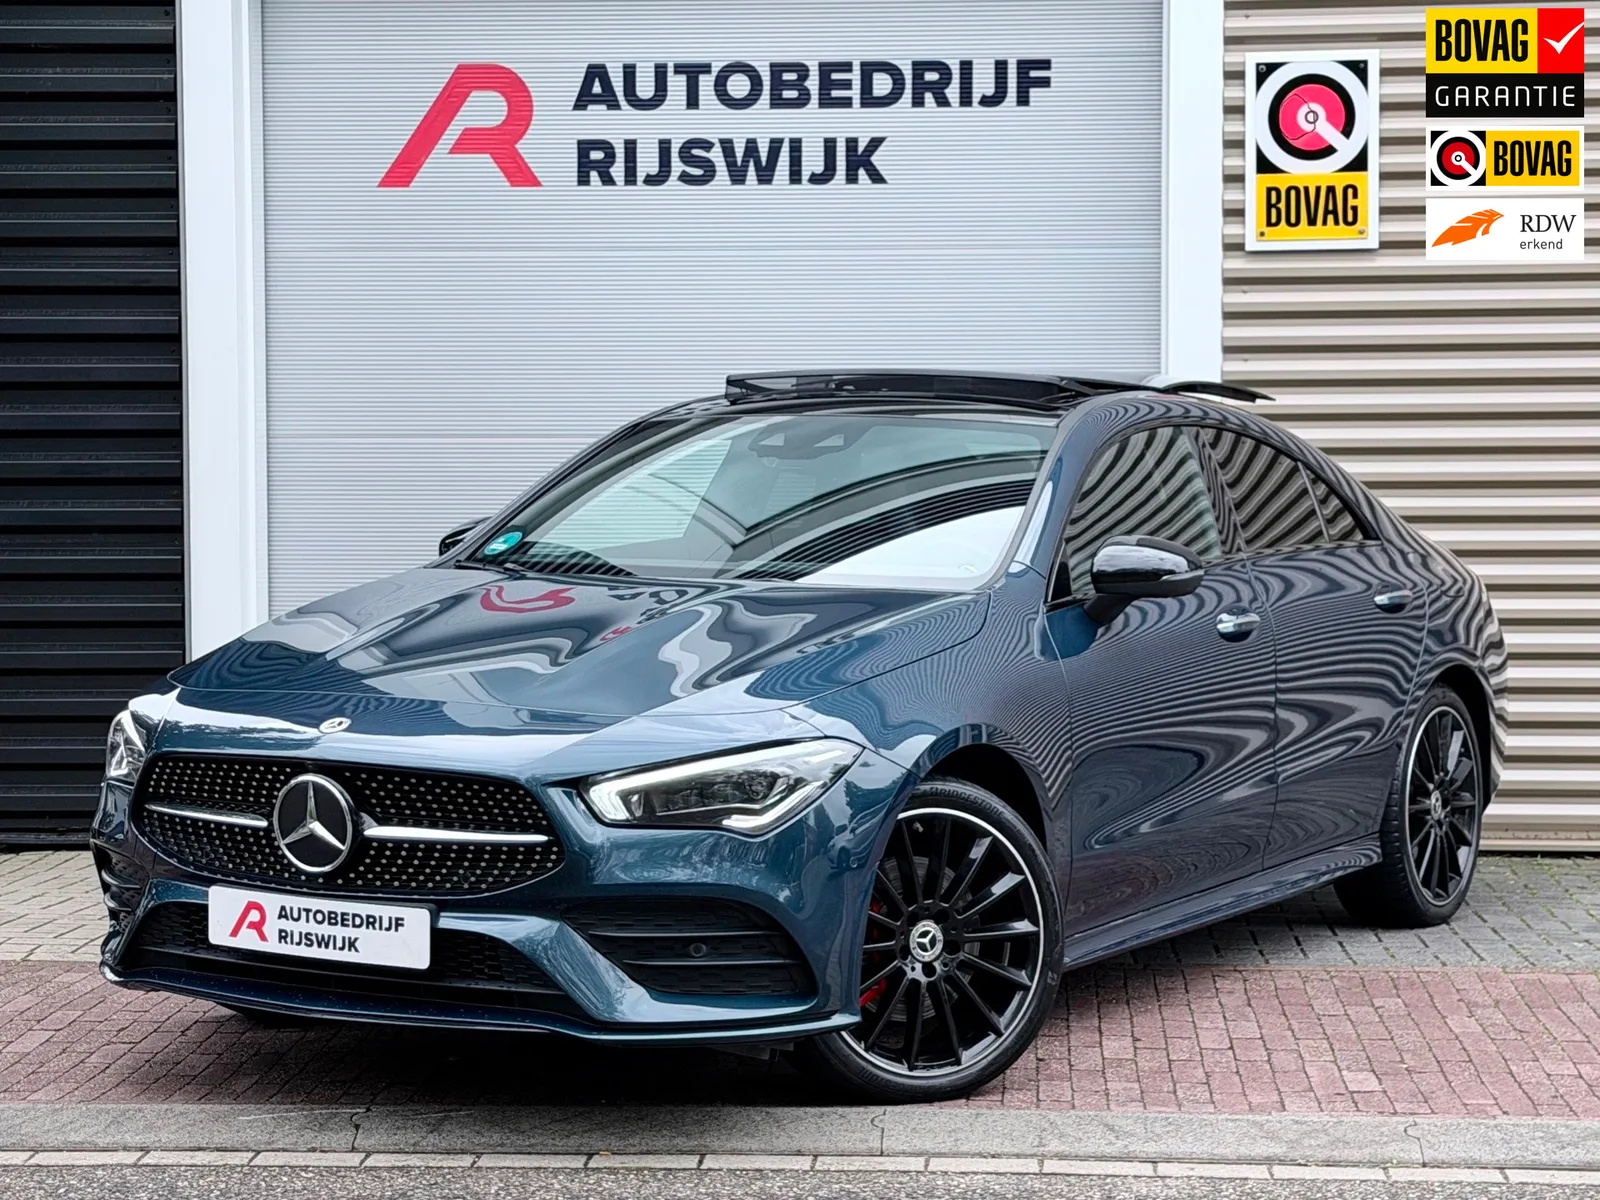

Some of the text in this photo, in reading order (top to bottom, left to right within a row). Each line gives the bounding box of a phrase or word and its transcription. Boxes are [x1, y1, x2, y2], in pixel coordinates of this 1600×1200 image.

[573, 58, 1052, 111] AUTOBEDRIJF
[576, 136, 888, 187] RIJSWIJK
[1265, 184, 1359, 228] BOVAG
[277, 904, 406, 933] AUTOBEDRIJF
[277, 928, 361, 953] RIJSWIJK
